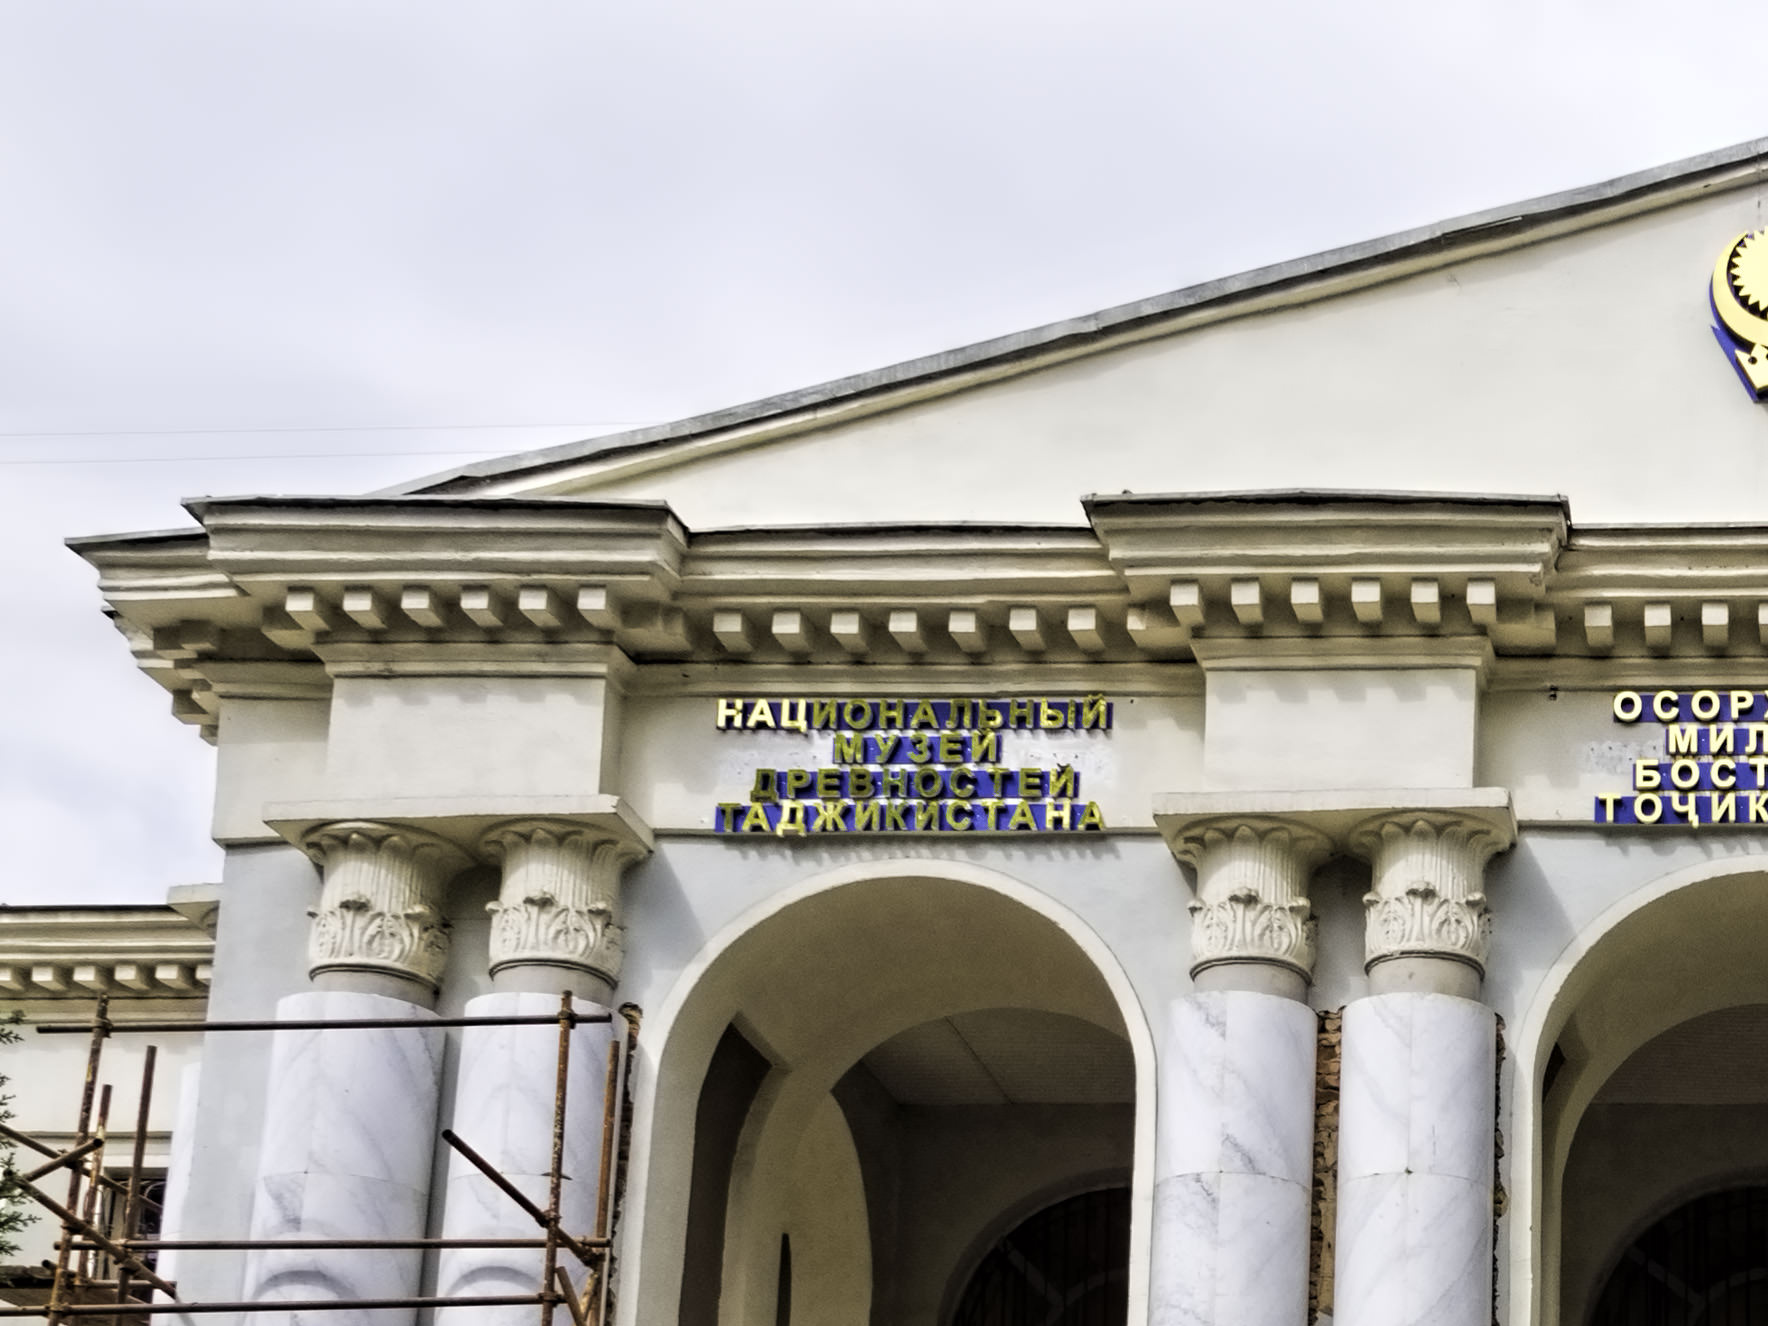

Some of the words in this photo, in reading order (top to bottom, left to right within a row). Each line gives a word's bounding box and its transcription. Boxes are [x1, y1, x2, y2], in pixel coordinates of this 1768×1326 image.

[717, 695, 1108, 733] НАЦИОНАЛЬНЫЙ
[834, 728, 998, 764] МУЗЕЙ
[750, 763, 1075, 802] ДРЕВНОСТЕЙ
[717, 801, 1108, 837] ТАДЖИКИСТАНА
